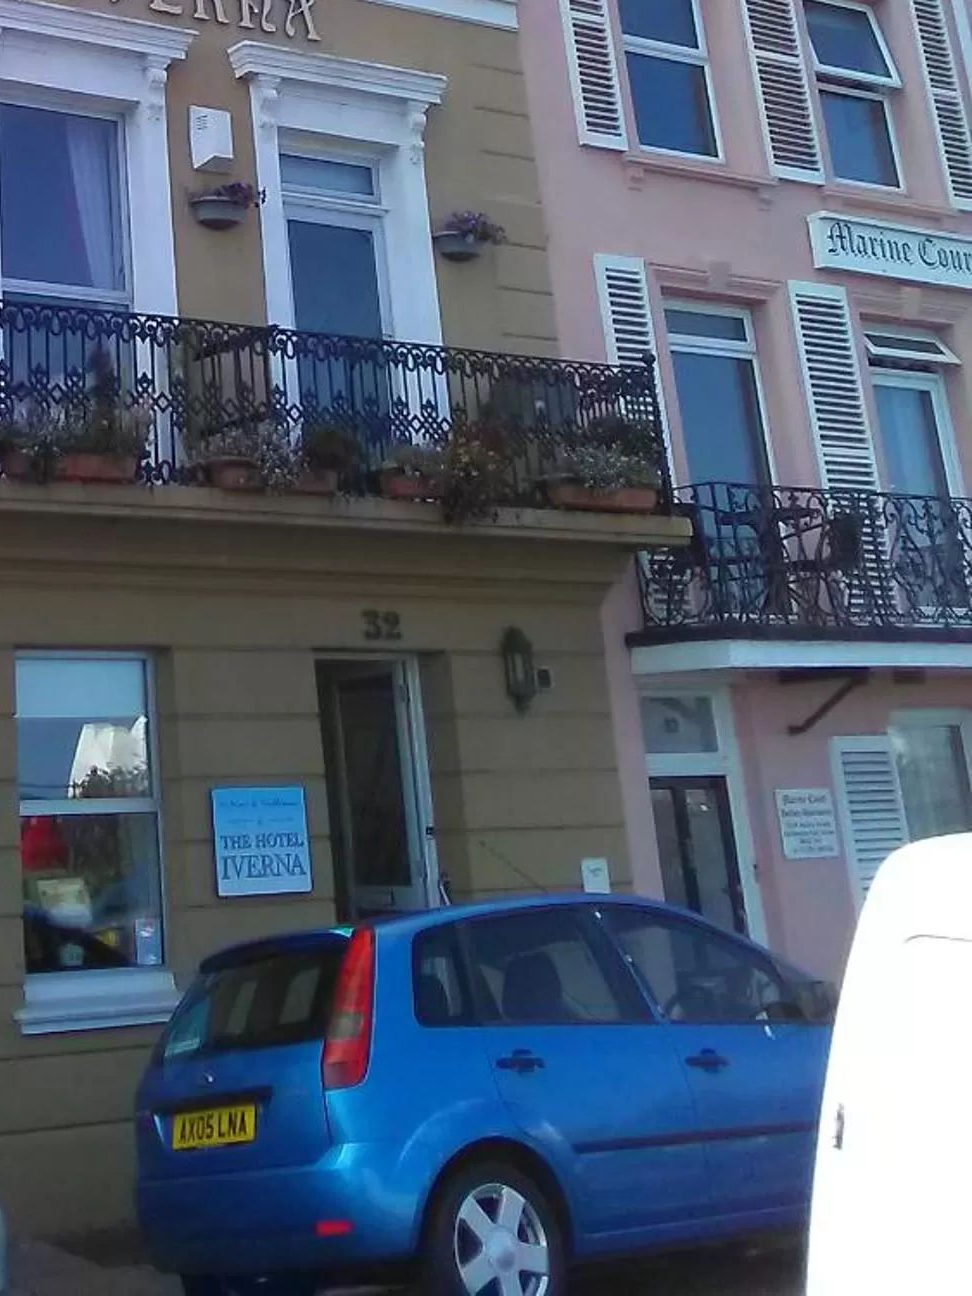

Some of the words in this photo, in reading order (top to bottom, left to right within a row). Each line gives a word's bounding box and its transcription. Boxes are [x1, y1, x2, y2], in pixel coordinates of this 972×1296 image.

[827, 222, 912, 263] Marine
[361, 609, 402, 640] 32
[220, 835, 252, 850] THE
[255, 832, 305, 848] HOTEL
[221, 852, 307, 881] IVERNA
[179, 1115, 214, 1144] AX05
[217, 1110, 247, 1138] LNA
